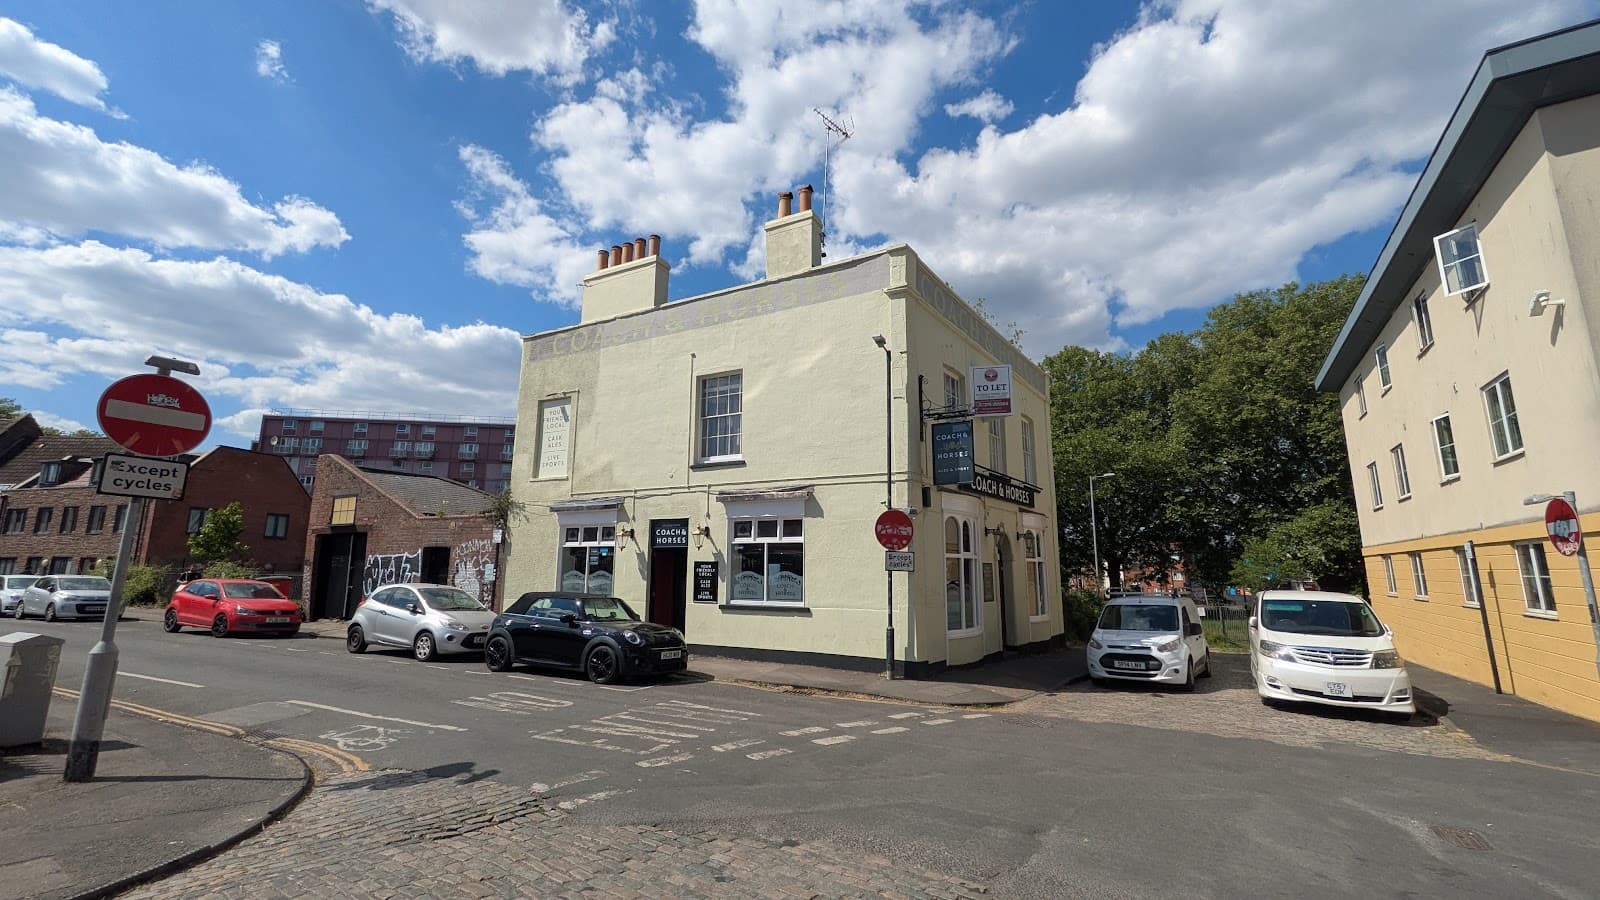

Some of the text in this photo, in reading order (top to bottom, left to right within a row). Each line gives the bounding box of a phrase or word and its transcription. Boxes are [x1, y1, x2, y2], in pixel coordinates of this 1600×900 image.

[937, 450, 969, 460] HORSES
[110, 460, 178, 478] Except
[113, 478, 172, 491] cycles
[998, 483, 1005, 497] &
[1005, 485, 1030, 504] HORSES
